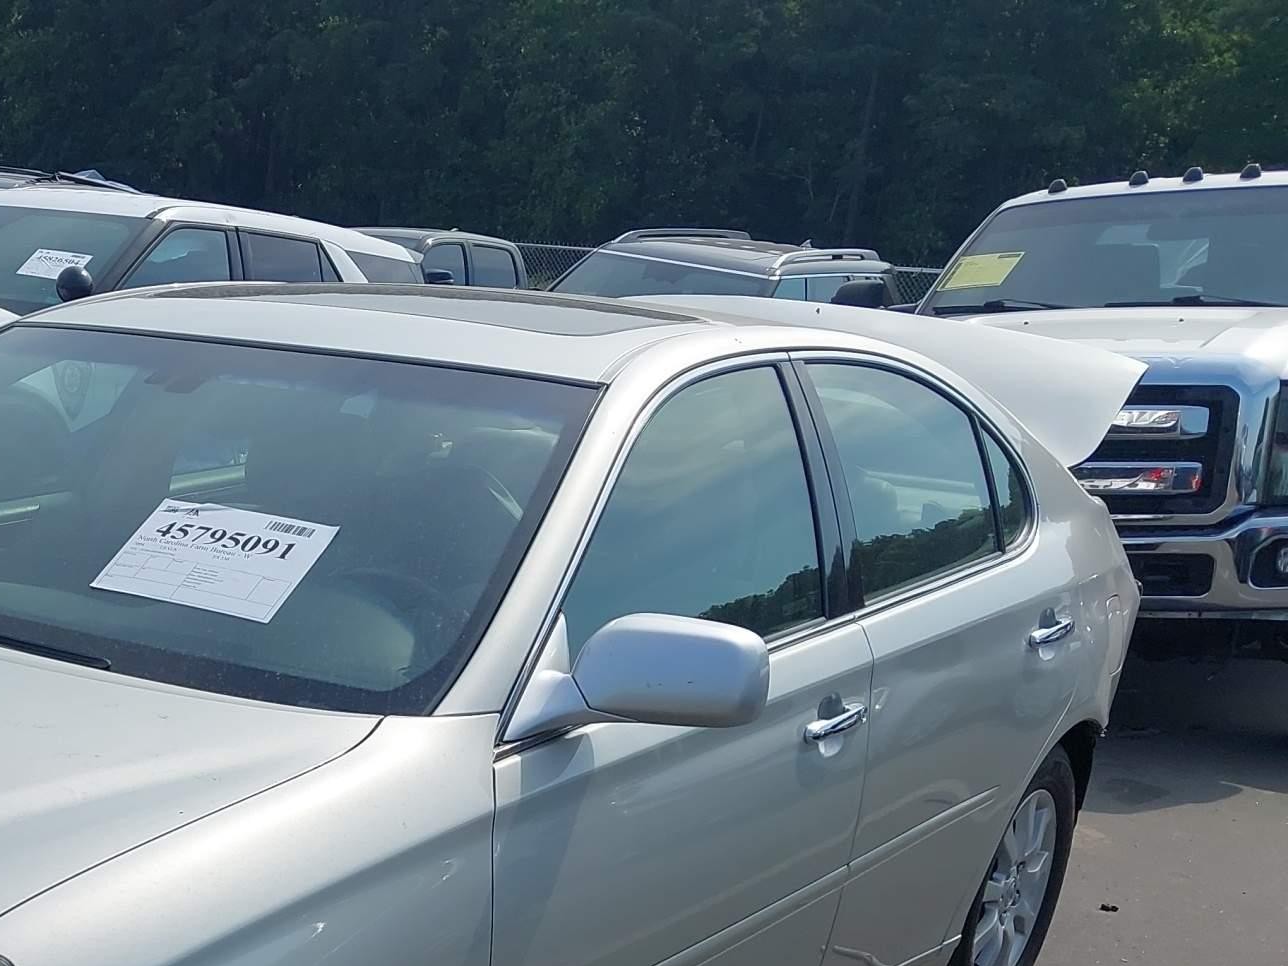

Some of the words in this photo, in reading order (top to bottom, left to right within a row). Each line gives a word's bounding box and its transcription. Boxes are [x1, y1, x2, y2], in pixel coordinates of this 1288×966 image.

[137, 535, 158, 543] North
[159, 537, 189, 548] Carolina
[156, 521, 297, 560] 45795091
